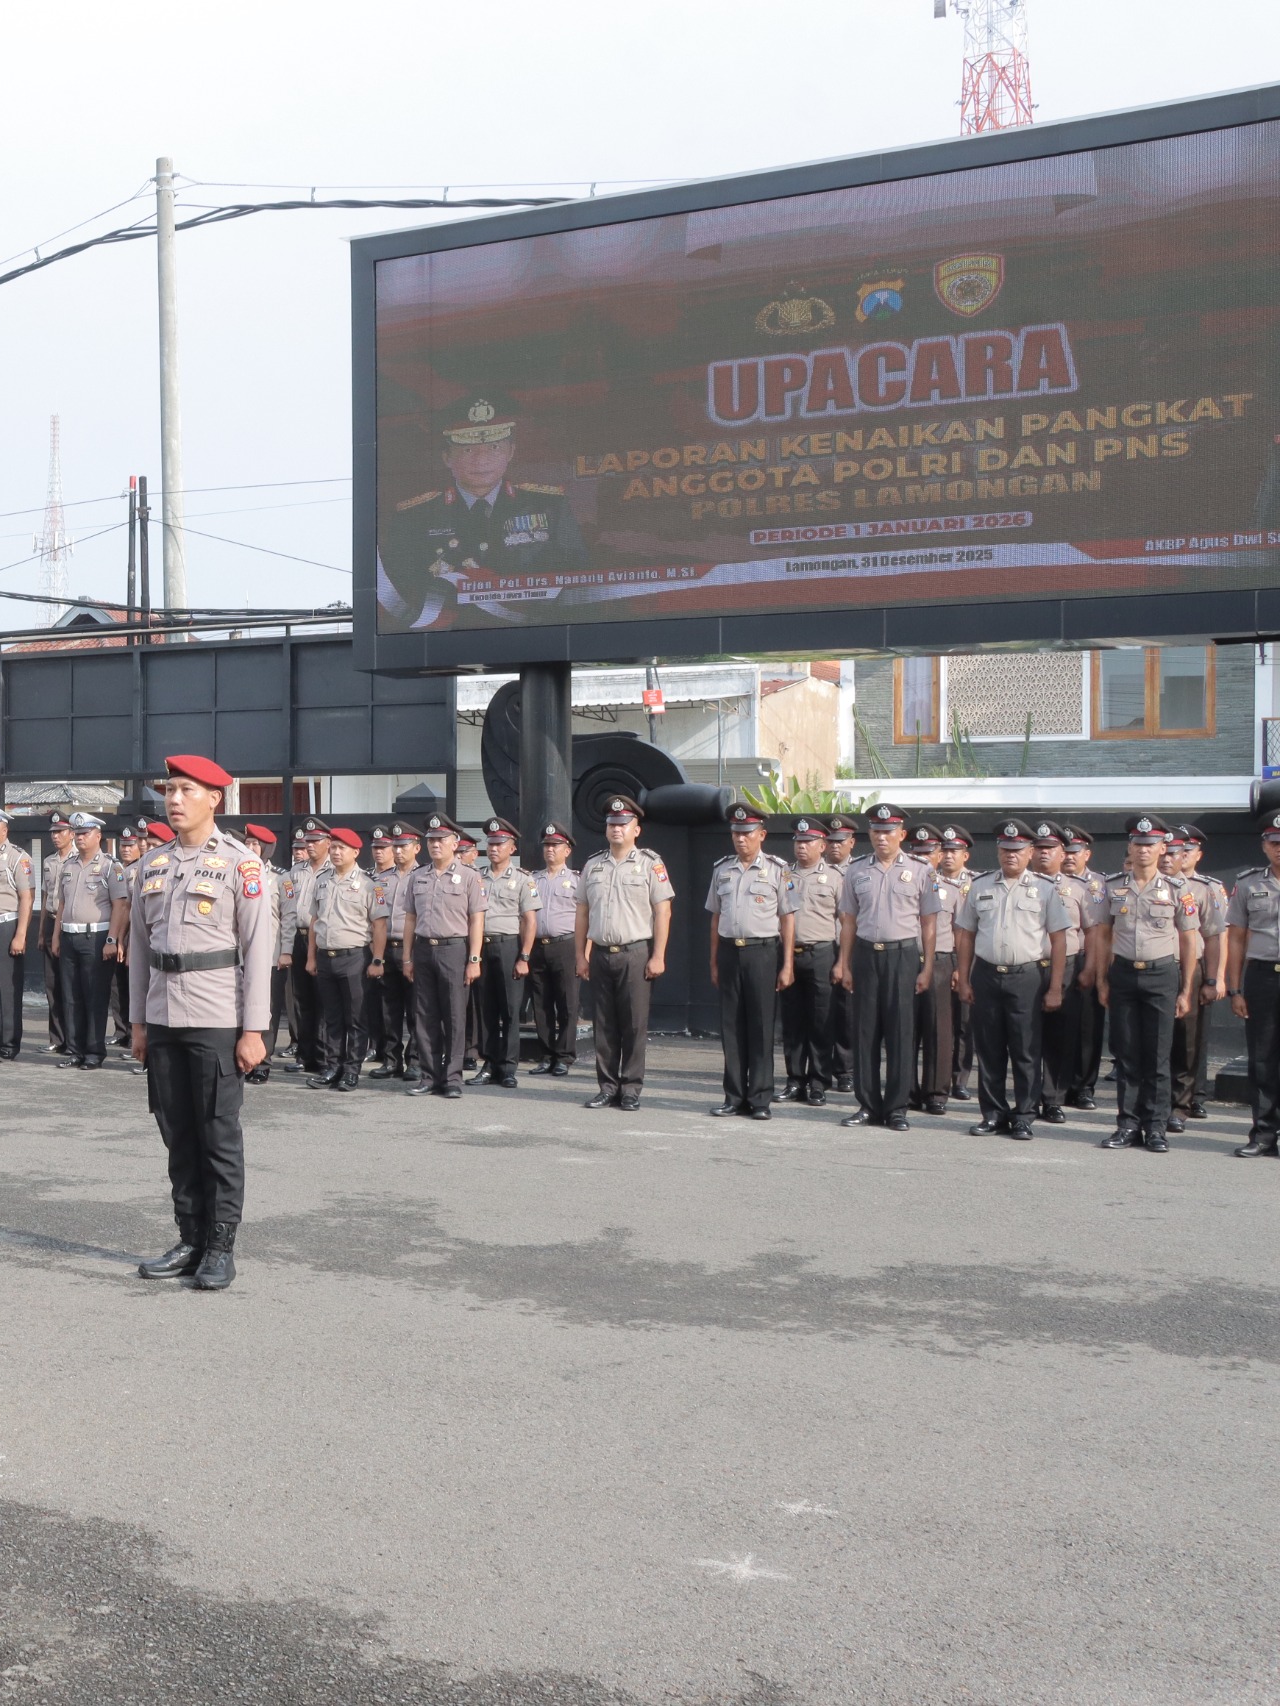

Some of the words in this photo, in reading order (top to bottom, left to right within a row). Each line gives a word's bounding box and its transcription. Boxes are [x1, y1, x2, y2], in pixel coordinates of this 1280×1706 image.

[709, 323, 1078, 427] UPACARA
[575, 438, 767, 477] LAPORAN
[780, 416, 1005, 458] KENAIKAN
[1021, 392, 1254, 437] PANGKAT
[623, 463, 820, 501] ANGGOTA
[833, 451, 962, 484] POLRI
[977, 441, 1077, 472] DAN
[1093, 431, 1190, 463] PNS
[691, 489, 841, 520] POLRES
[854, 469, 1102, 508] LAMONGAN
[753, 525, 848, 543] PERIODE
[853, 523, 861, 536] 1
[867, 516, 966, 535] JANUARI
[972, 512, 1027, 528] 2026
[1145, 538, 1186, 551] AKBP
[785, 557, 859, 573] Lamongan,
[861, 556, 878, 568] 31
[880, 550, 954, 567] Desember
[956, 548, 993, 563] 2025
[194, 869, 227, 881] POLRI
